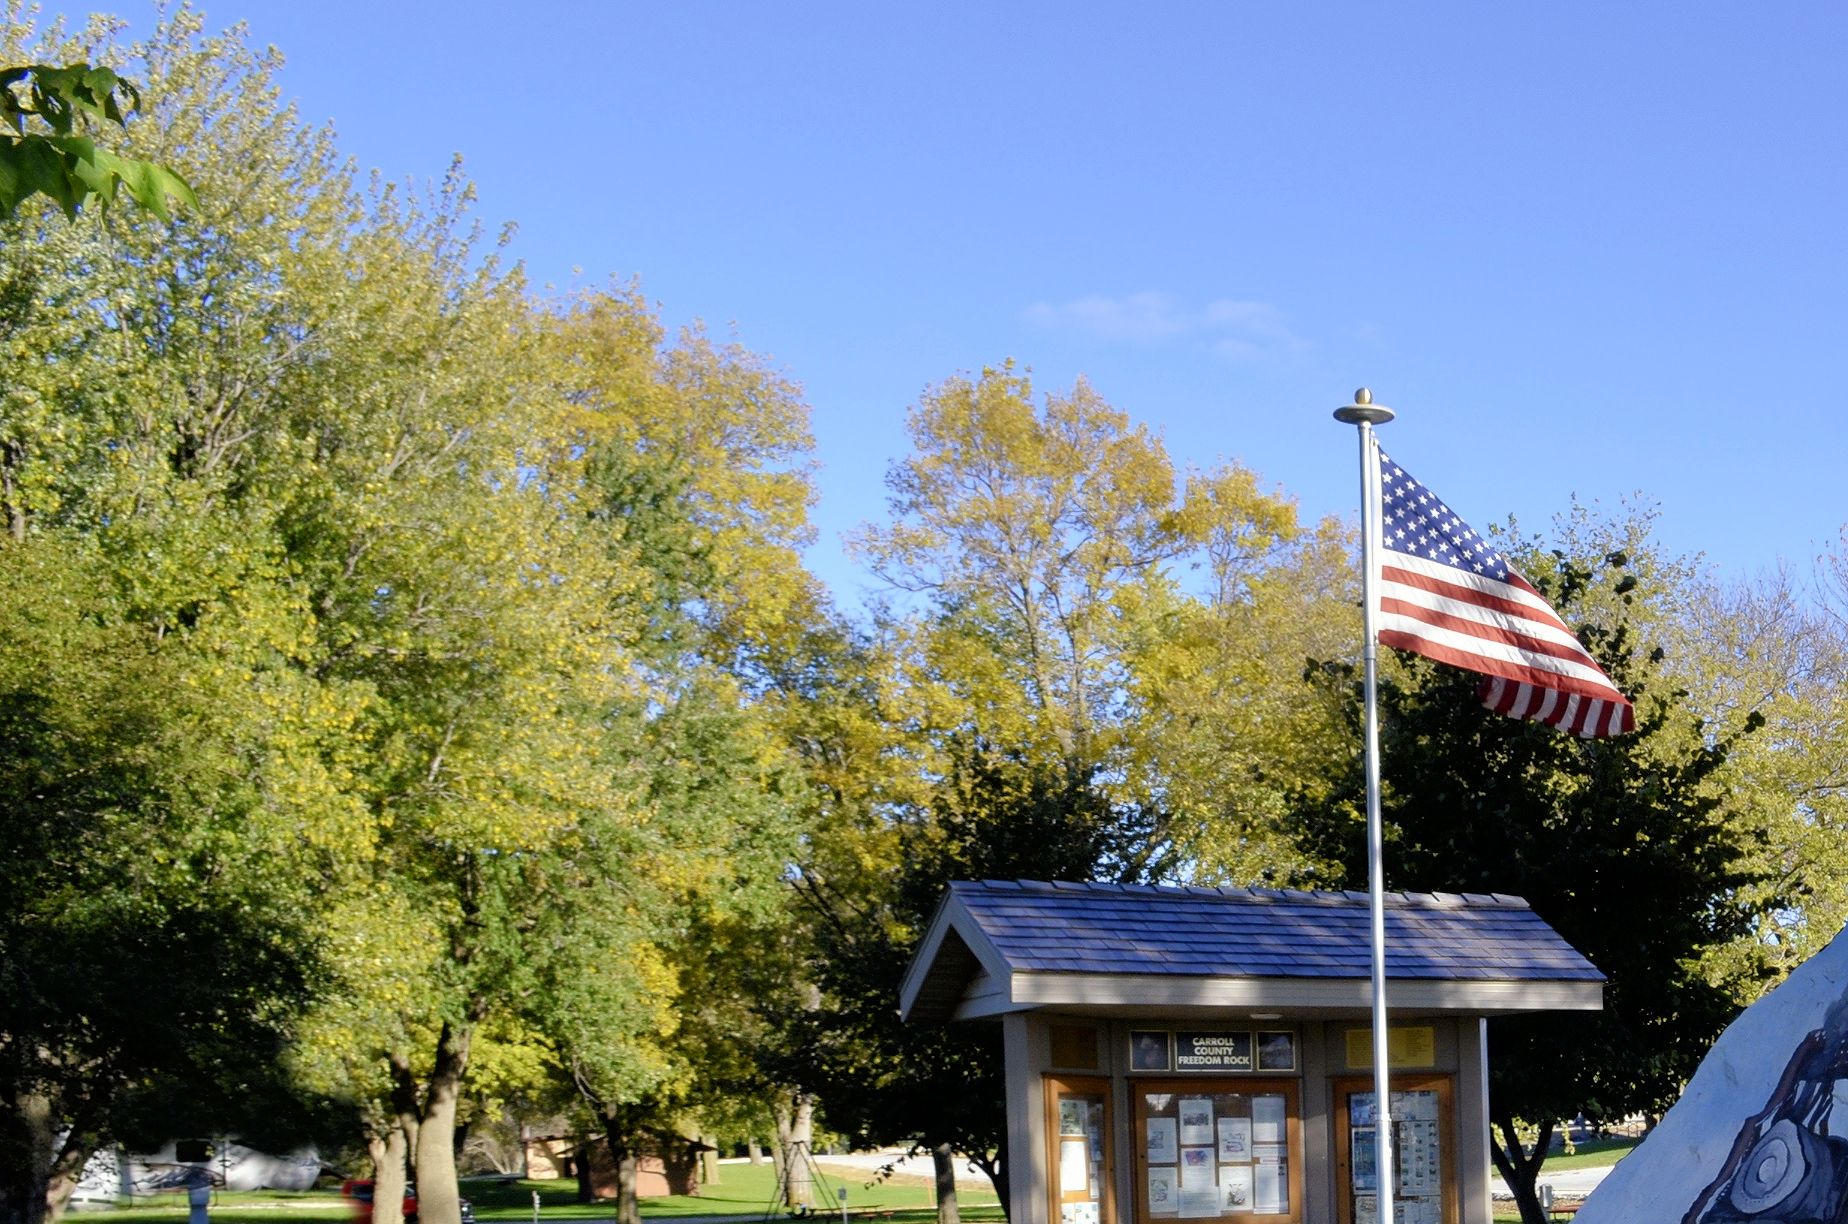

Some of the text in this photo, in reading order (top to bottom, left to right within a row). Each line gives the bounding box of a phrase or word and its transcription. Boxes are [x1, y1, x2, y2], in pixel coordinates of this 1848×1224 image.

[1192, 1037, 1235, 1046] CARROLL
[1194, 1046, 1234, 1056] COUNTY
[1178, 1055, 1250, 1065] FREEDOM ROCK
